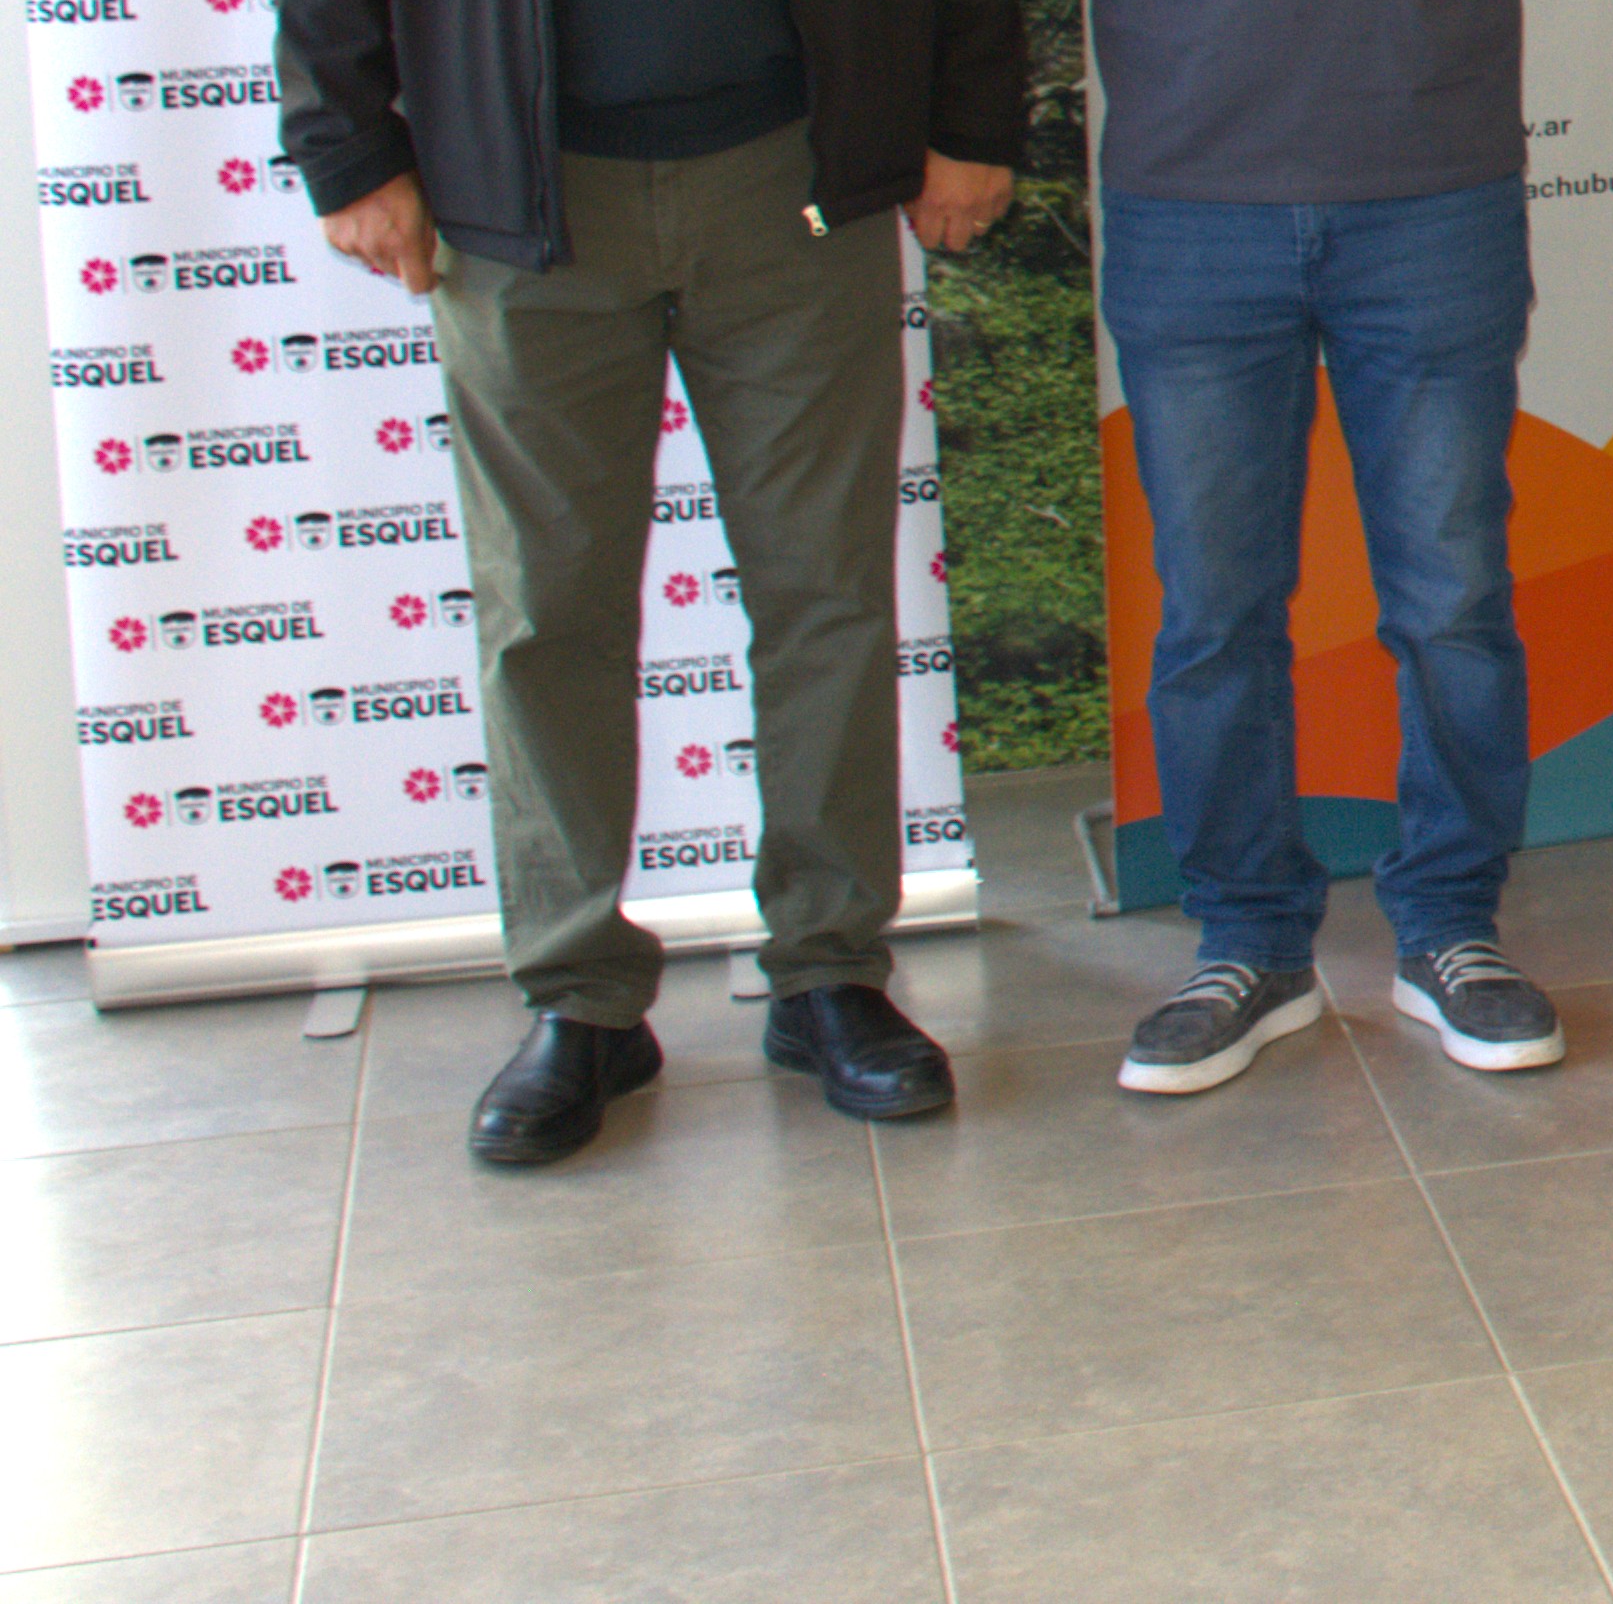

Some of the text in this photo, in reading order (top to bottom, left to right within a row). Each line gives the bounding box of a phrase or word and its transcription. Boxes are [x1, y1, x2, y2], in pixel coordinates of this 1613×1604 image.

[188, 423, 299, 442] MUNICIPIO DE
[189, 440, 311, 469] ESQUEL
[351, 676, 462, 696] MUNICIPIO DE
[352, 691, 472, 723] ESQUEL
[366, 848, 475, 868] MUNICIPIO DE
[368, 864, 485, 895] ESQUEL
